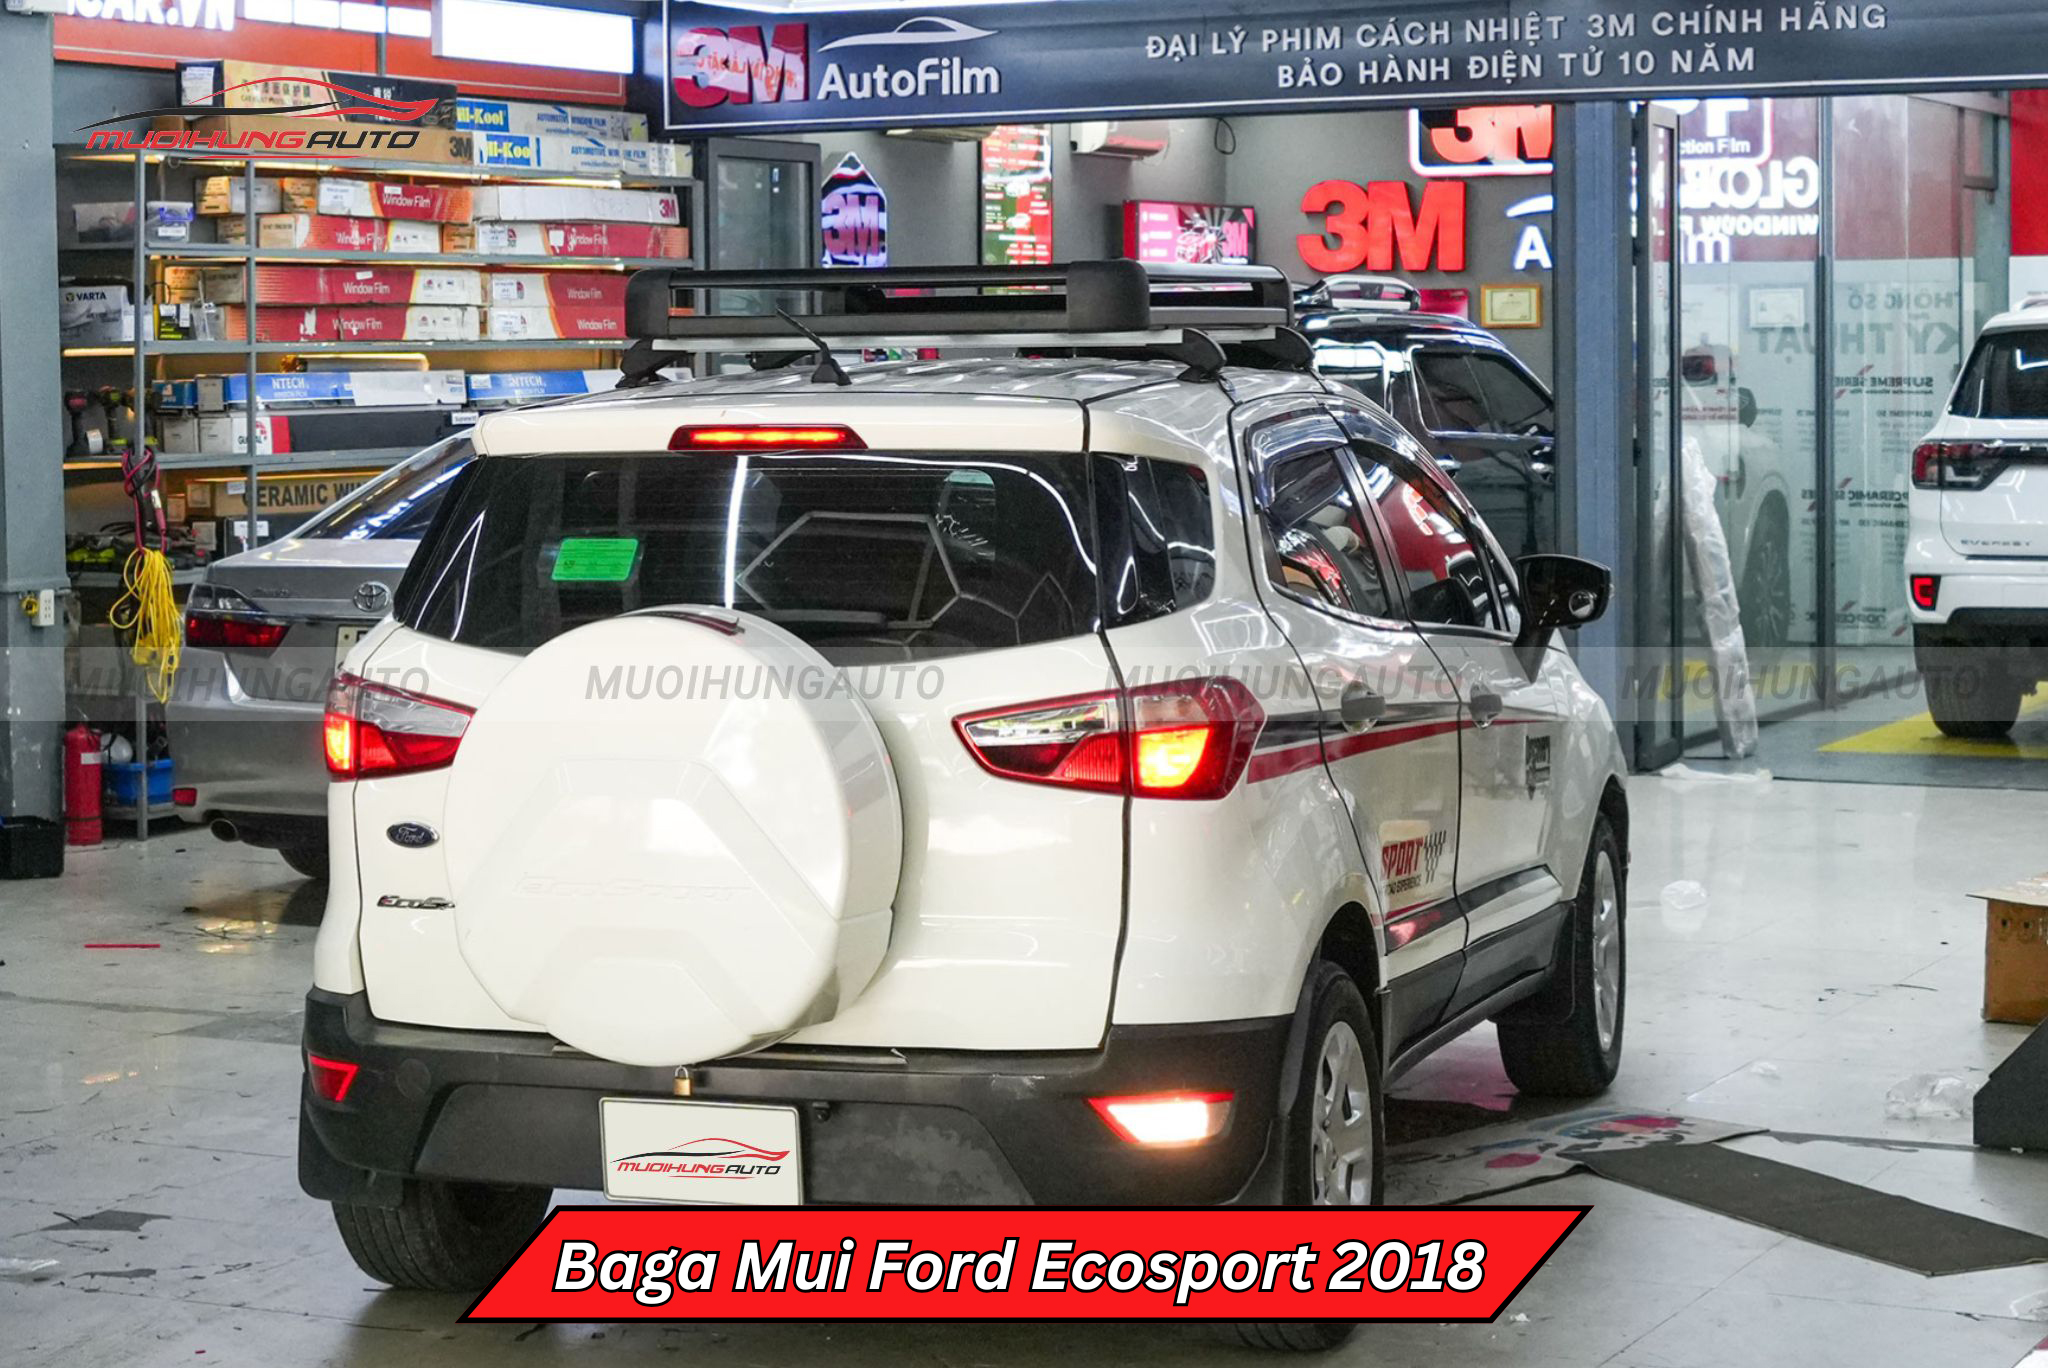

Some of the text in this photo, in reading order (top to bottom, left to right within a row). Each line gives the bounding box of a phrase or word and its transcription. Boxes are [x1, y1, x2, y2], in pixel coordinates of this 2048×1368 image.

[1145, 1, 1886, 62] ĐẠI LÝ PHIM CÁCH NHIỆT 3M CHÍNH HÃNG
[673, 22, 809, 108] 3M
[1278, 43, 1755, 88] BẢO HÀNH ĐIỆN TỬ 10 NĂM
[817, 57, 999, 101] AutoFilm
[449, 135, 473, 160] 3M
[383, 193, 431, 209] Window Film
[659, 198, 676, 220] 3M
[822, 193, 880, 257] 3M
[1296, 180, 1467, 273] 3M
[76, 292, 107, 301] VARTA
[343, 281, 391, 295] Window Film
[568, 287, 603, 300] Window Film
[332, 318, 383, 331] Window Film
[577, 319, 617, 331] Window Film
[395, 826, 425, 844] Ford
